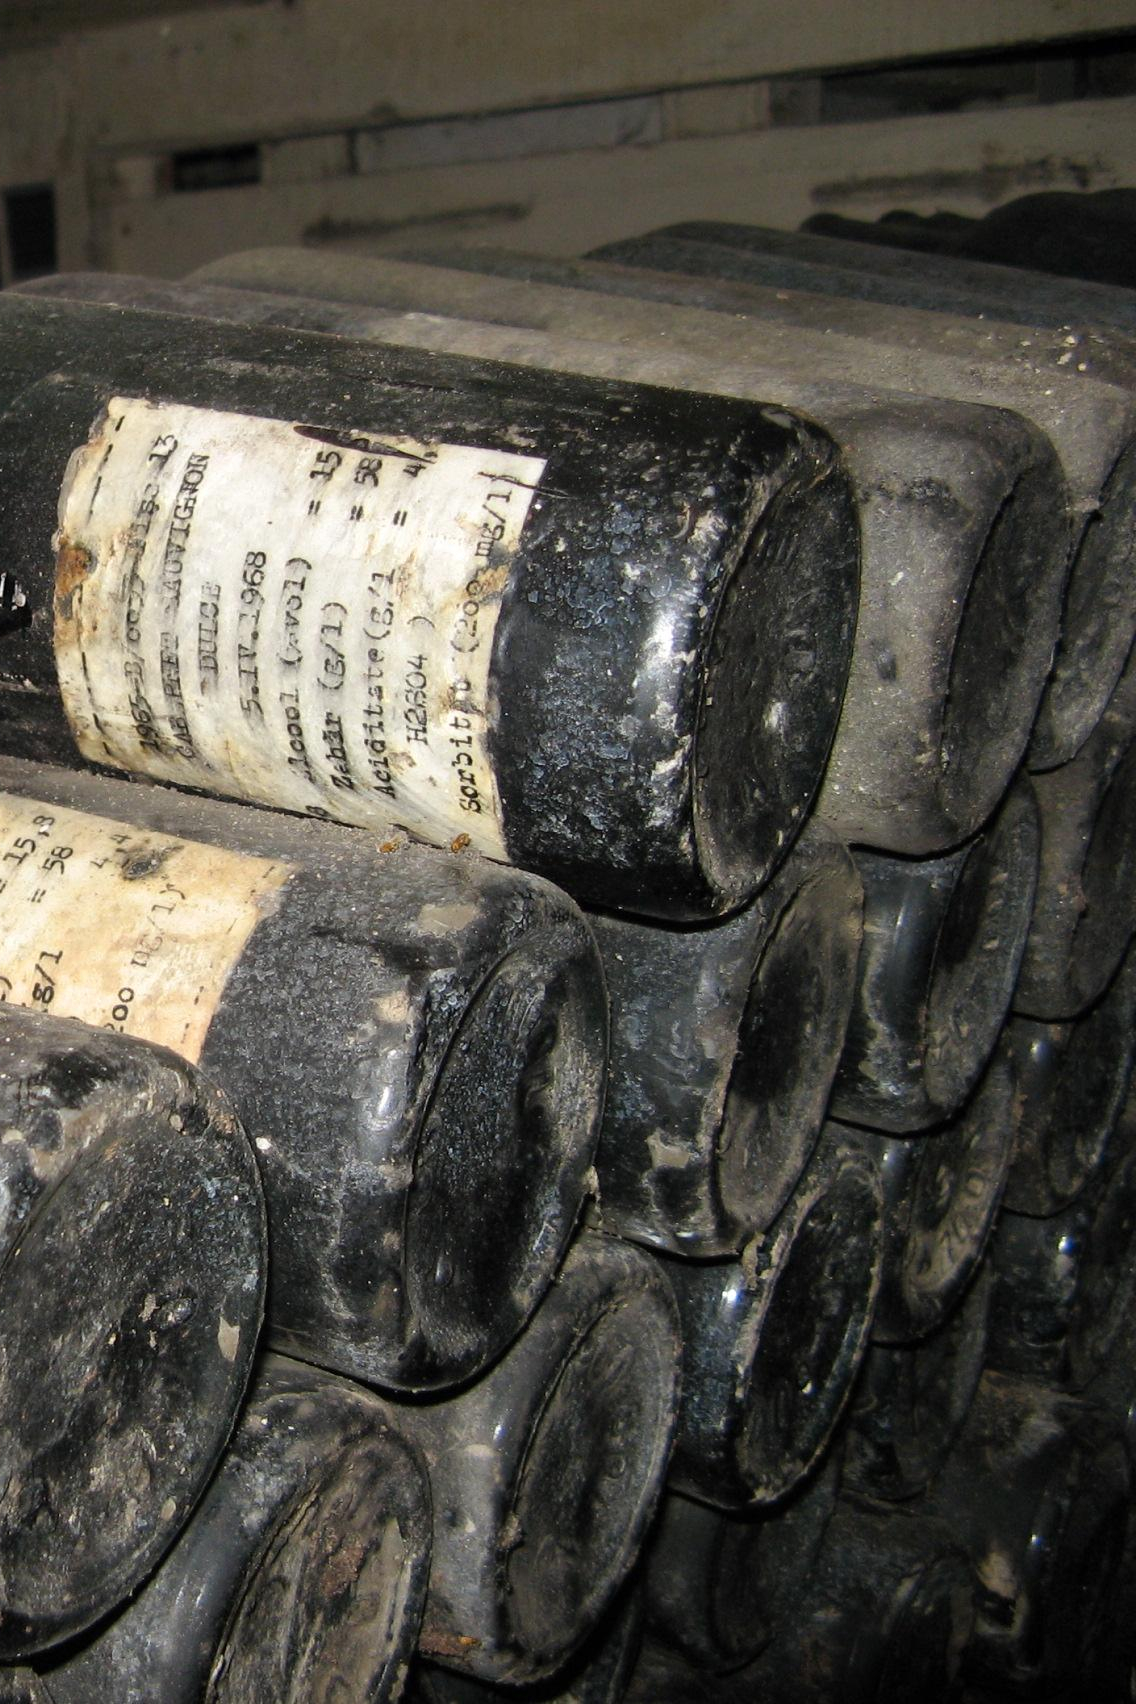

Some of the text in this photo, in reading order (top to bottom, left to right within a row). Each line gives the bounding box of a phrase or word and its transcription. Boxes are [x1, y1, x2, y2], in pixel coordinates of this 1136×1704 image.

[149, 434, 179, 470] 13
[354, 458, 383, 487] 58
[198, 584, 222, 675] DULCE
[237, 551, 267, 715] 5.IV.1968
[42, 846, 74, 876] 58
